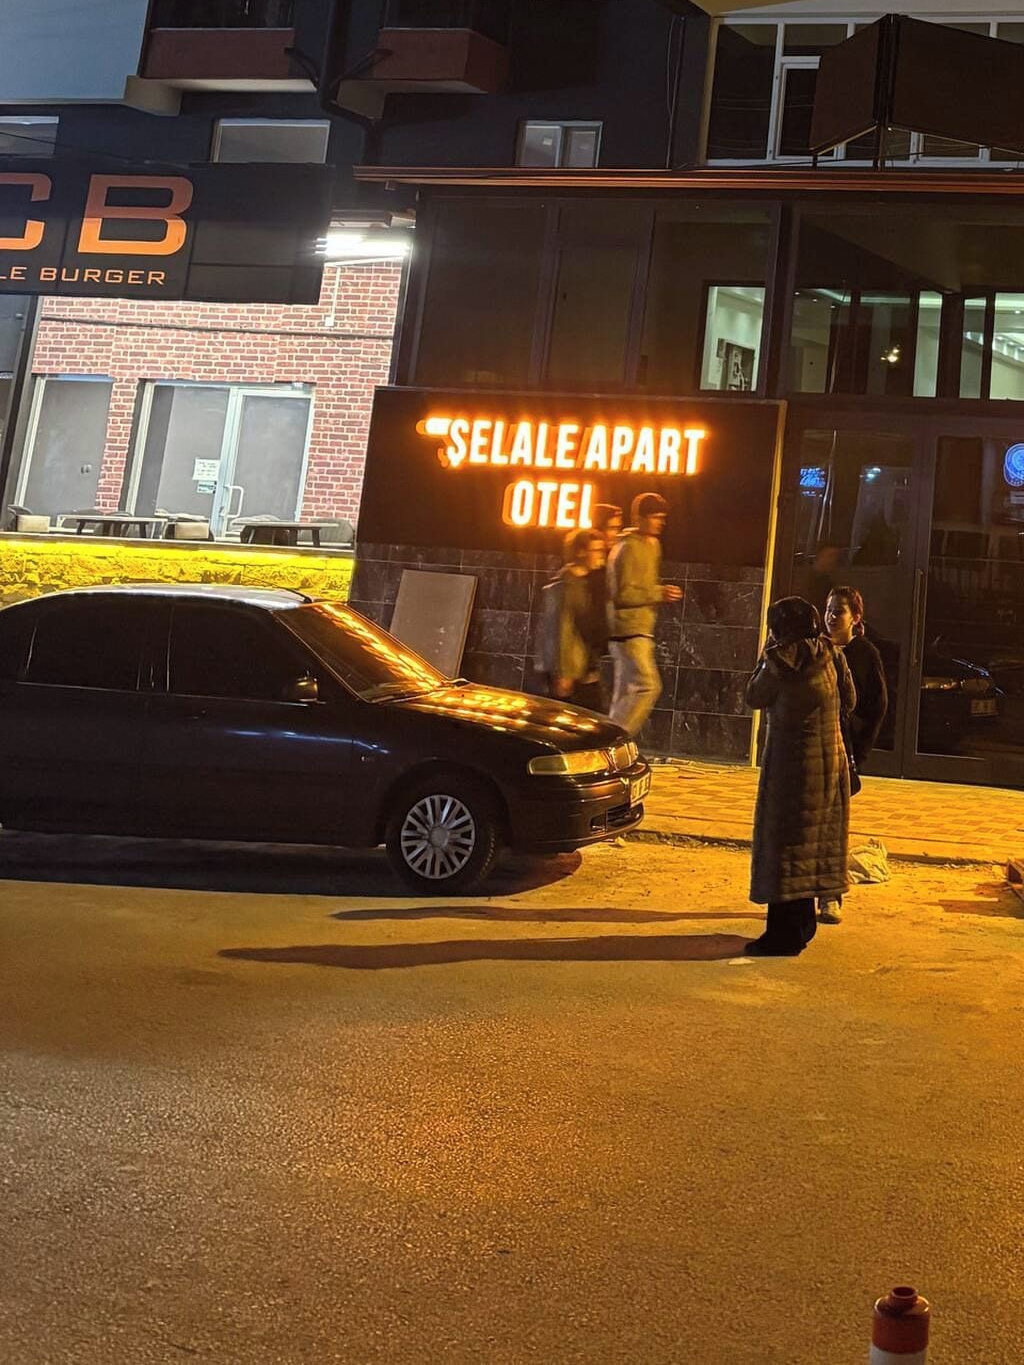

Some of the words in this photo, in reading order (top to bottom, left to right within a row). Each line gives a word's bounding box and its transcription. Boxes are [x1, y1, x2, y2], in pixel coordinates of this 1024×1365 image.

[39, 267, 167, 285] BURGER
[584, 425, 706, 476] APART
[503, 480, 594, 529] OTEL
